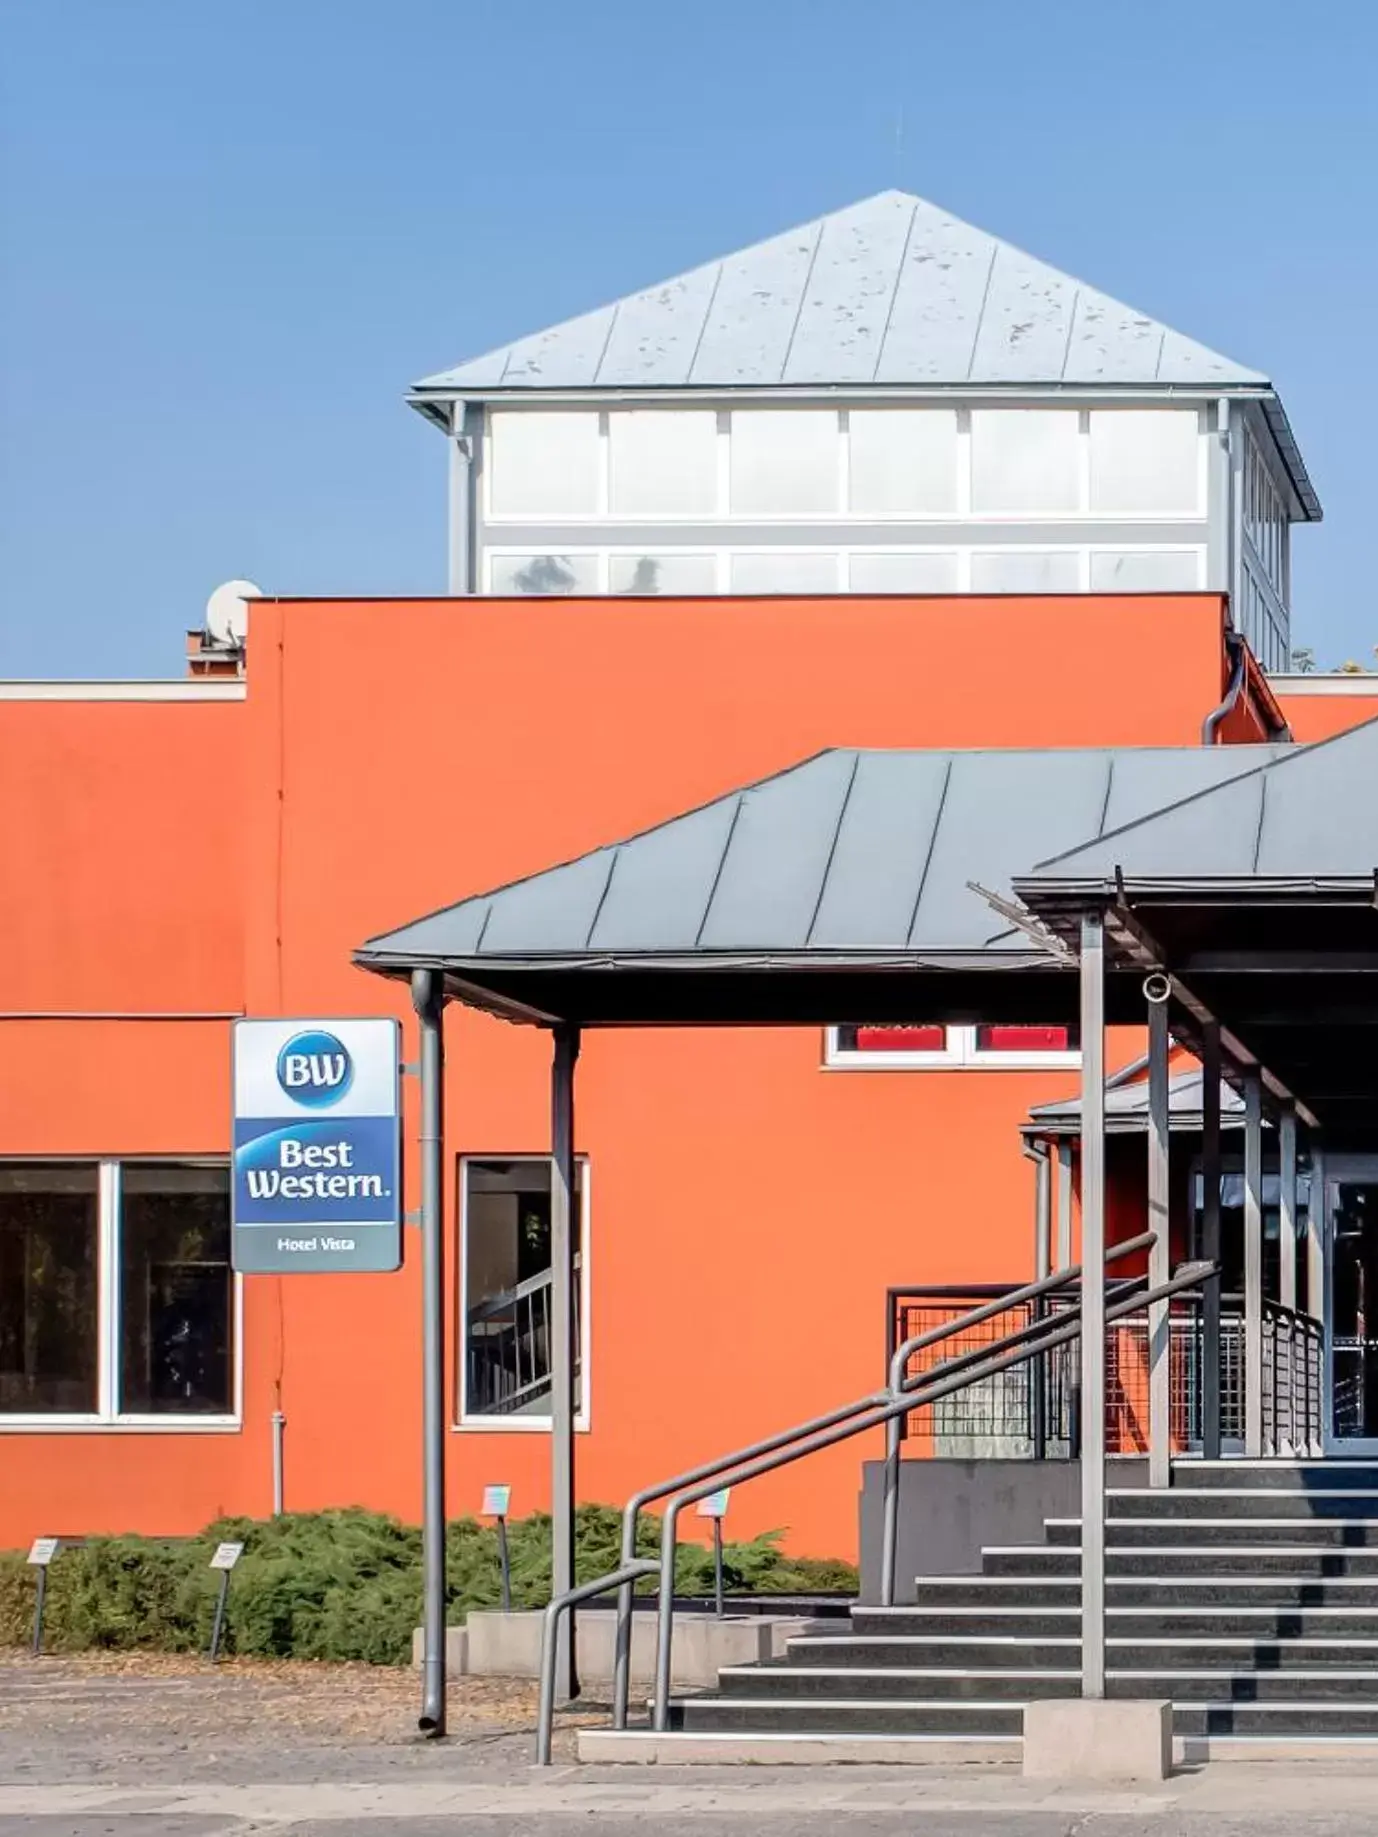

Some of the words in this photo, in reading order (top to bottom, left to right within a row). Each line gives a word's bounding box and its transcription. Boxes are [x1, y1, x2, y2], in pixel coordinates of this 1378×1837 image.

[285, 1054, 346, 1087] BW
[280, 1140, 353, 1169] Best
[277, 1237, 317, 1251] Hotel
